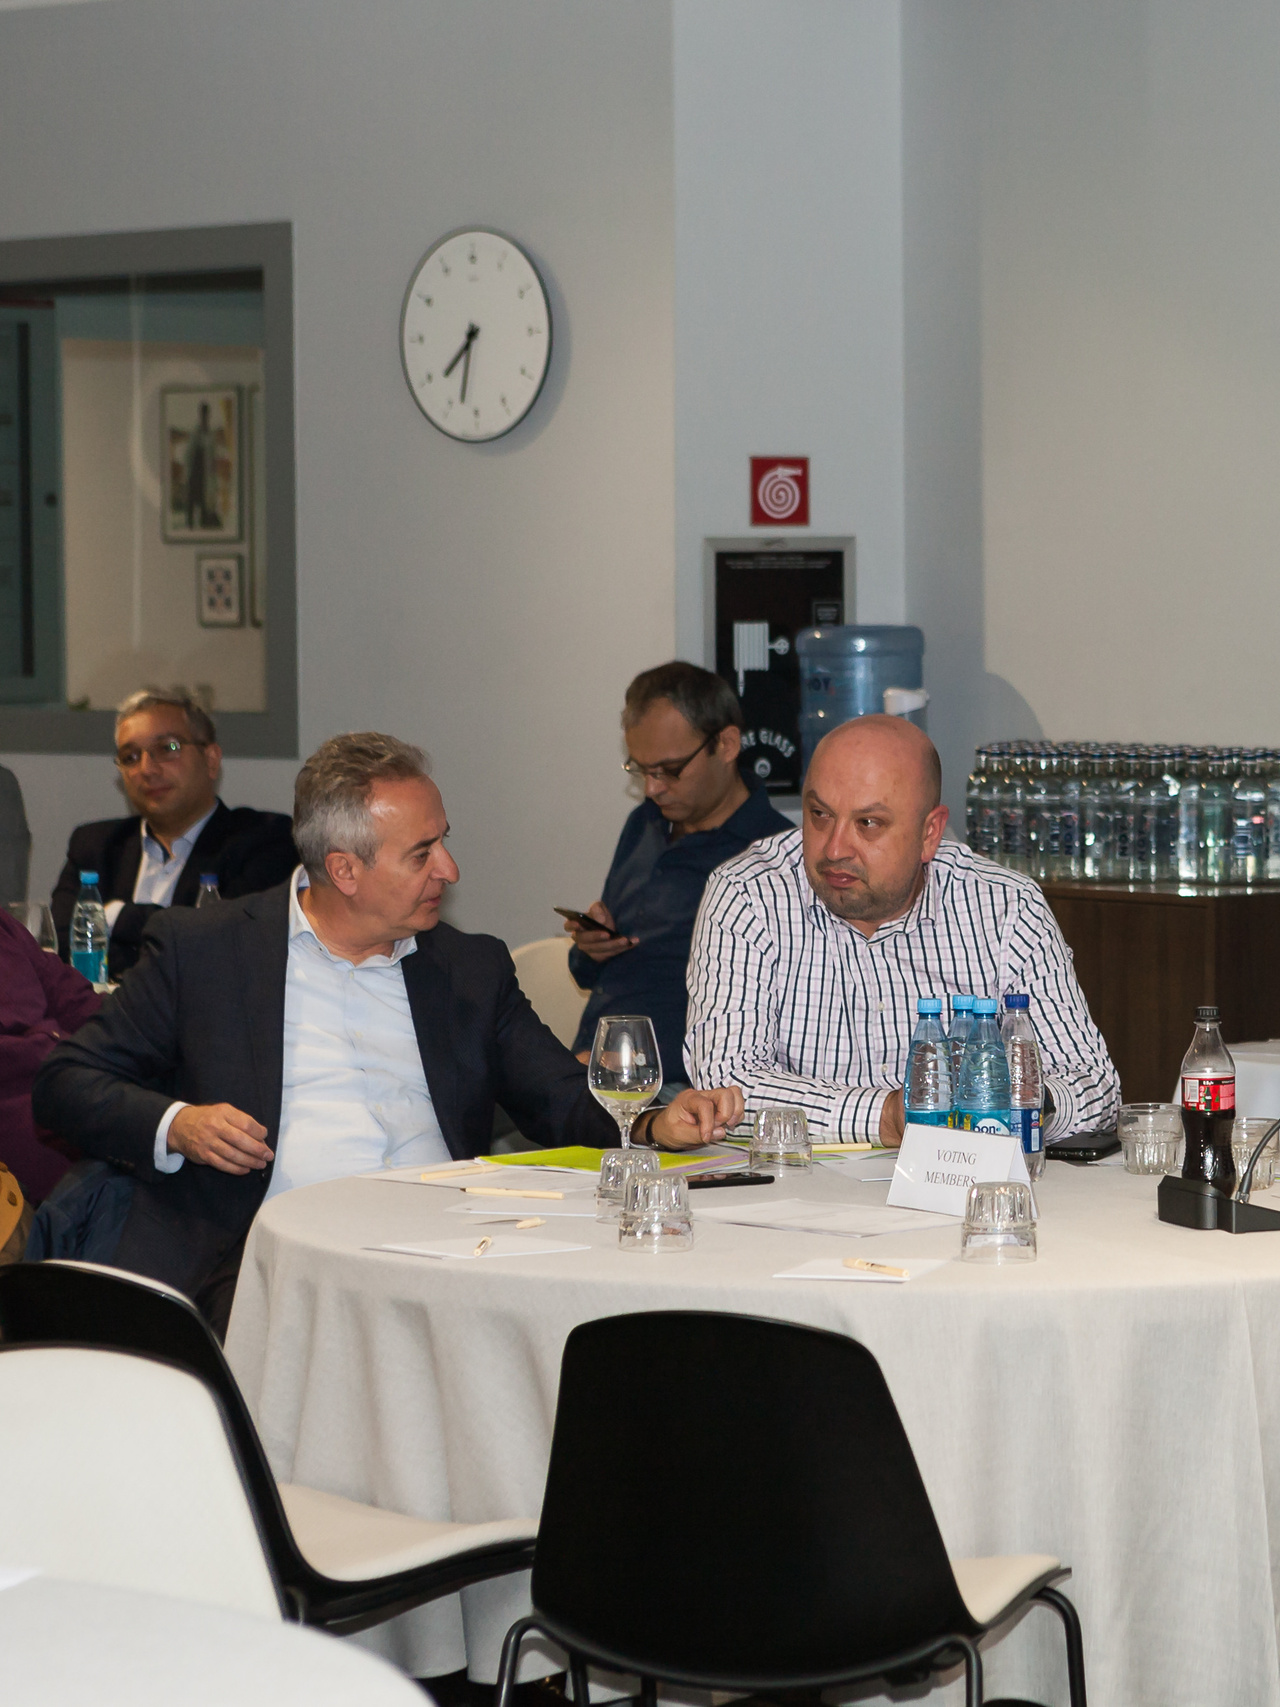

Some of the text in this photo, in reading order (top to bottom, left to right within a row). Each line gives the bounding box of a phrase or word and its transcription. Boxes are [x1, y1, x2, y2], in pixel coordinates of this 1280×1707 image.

[759, 728, 796, 758] GLASS
[936, 1149, 977, 1166] VOTING
[924, 1170, 977, 1188] MEMBERS
